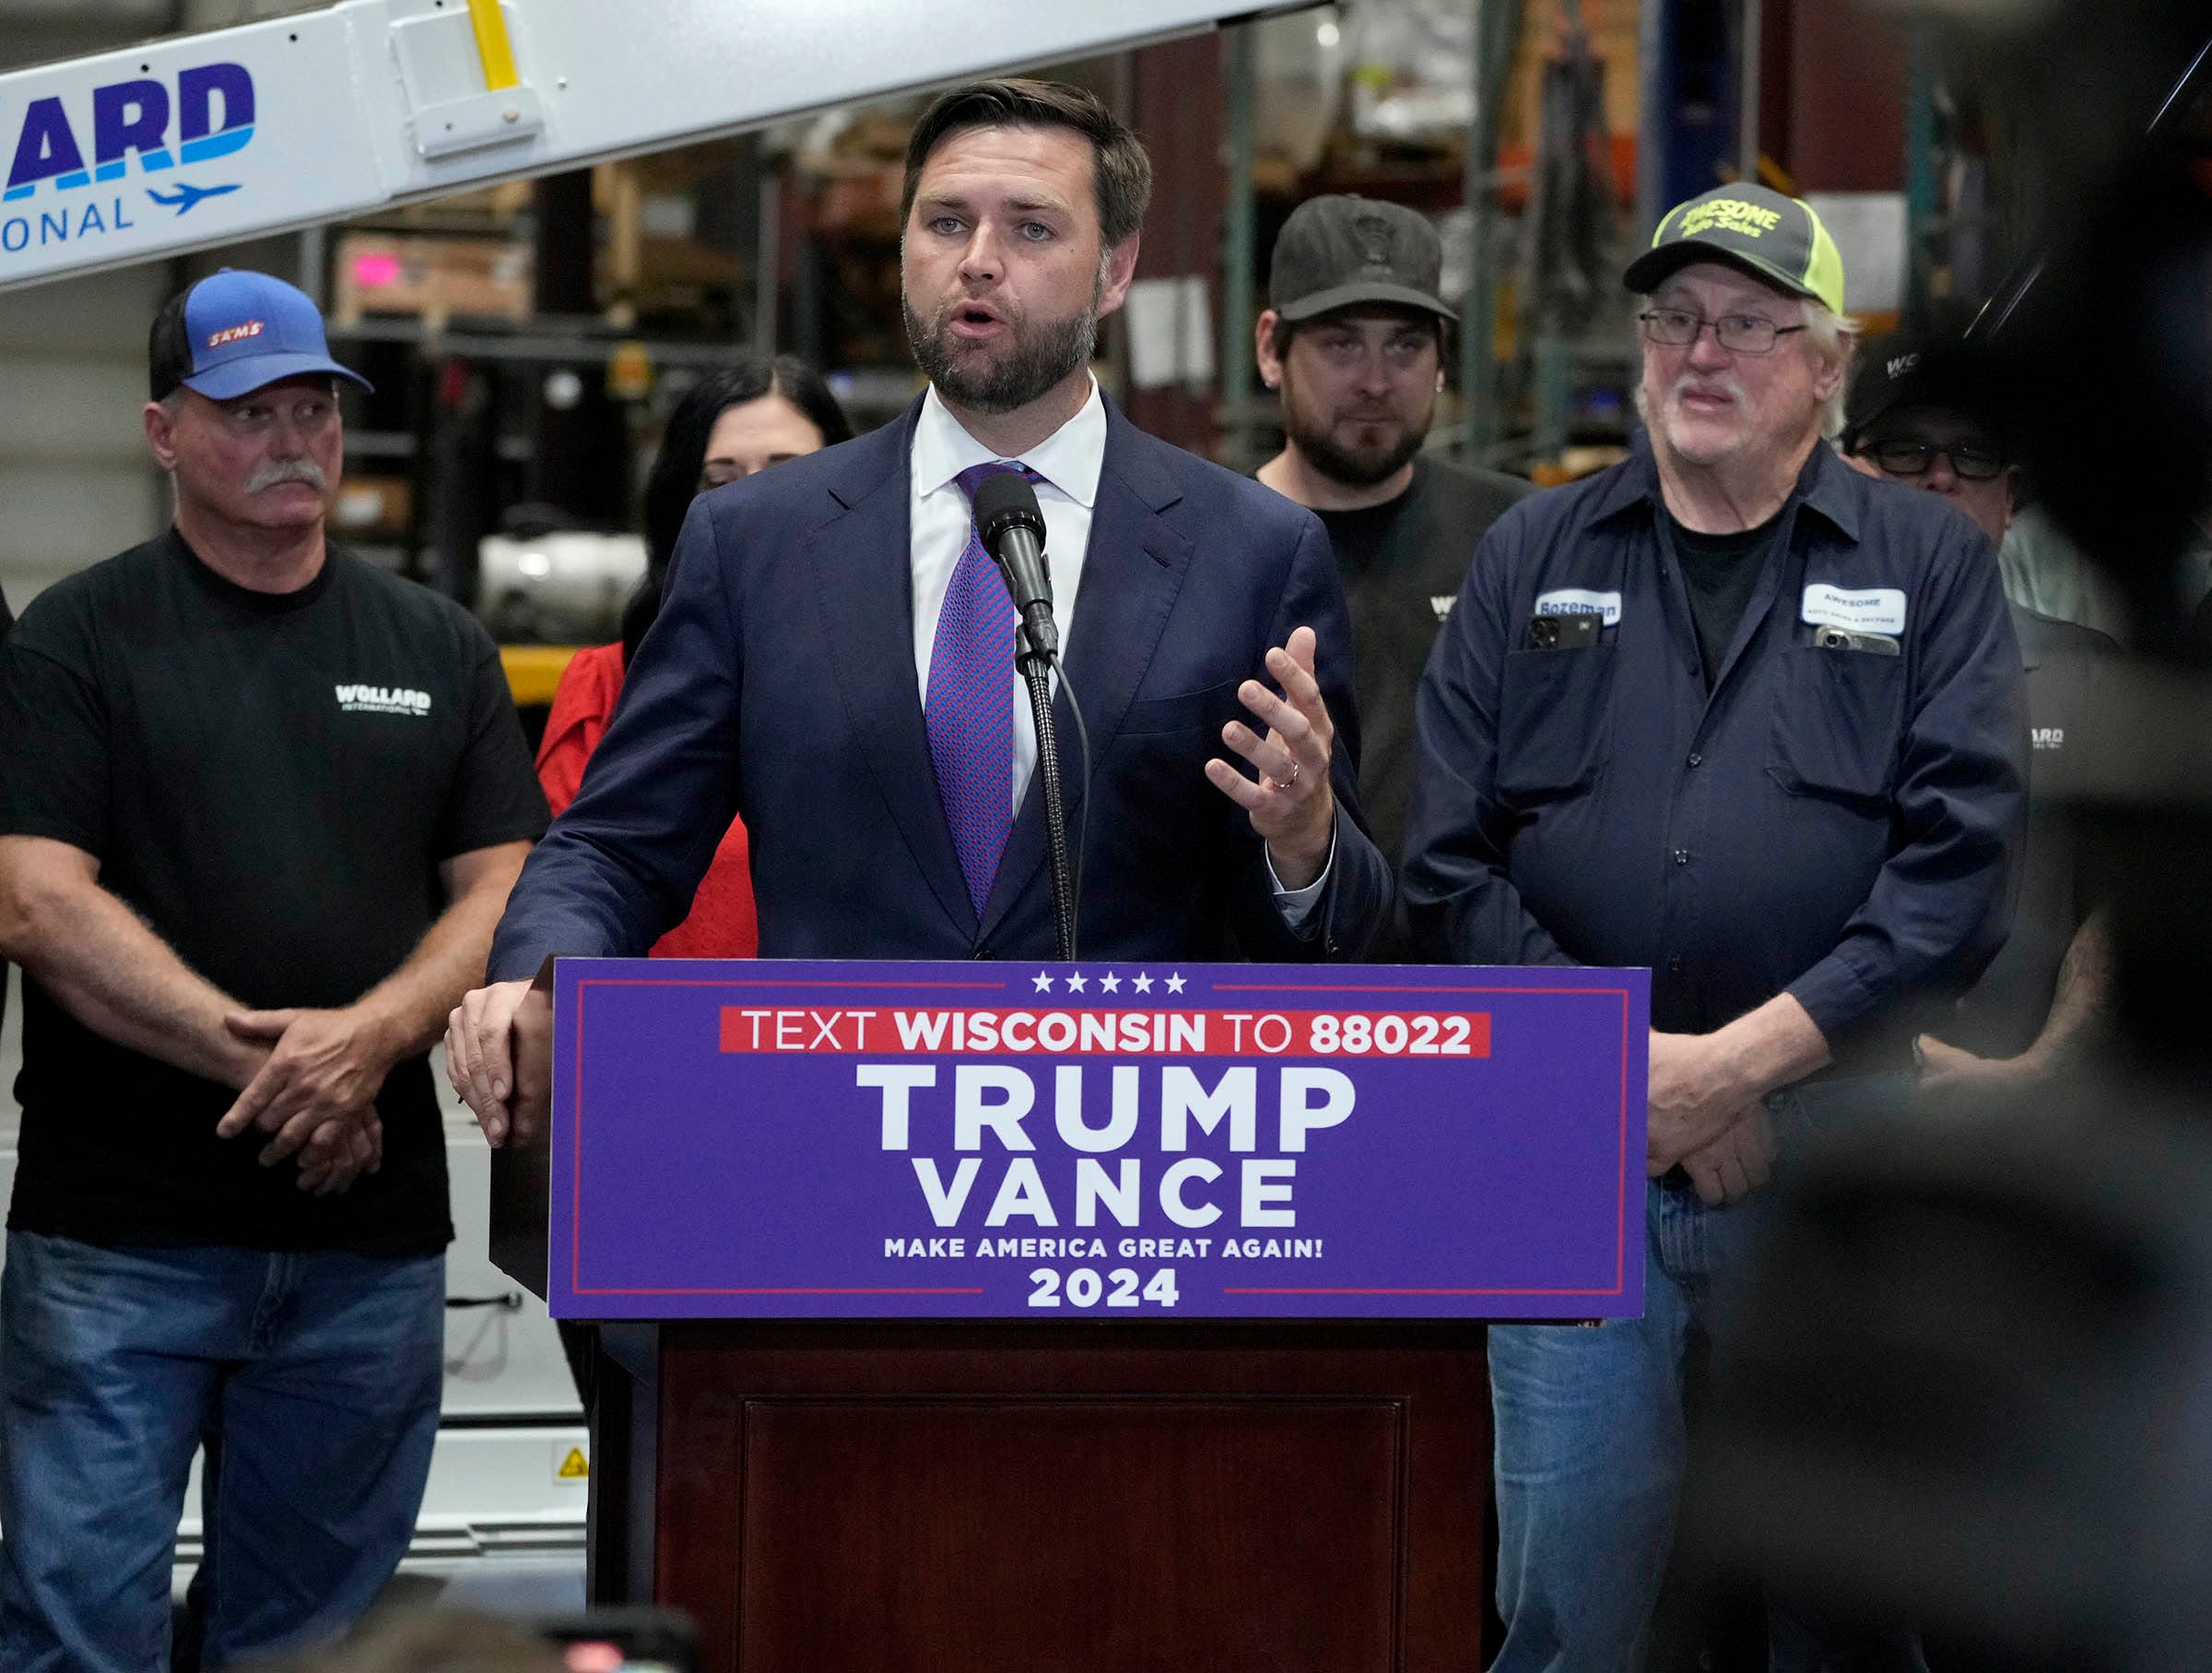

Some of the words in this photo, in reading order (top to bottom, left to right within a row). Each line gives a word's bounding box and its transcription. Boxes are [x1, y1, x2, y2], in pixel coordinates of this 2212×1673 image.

[1824, 593, 1880, 607] AWESOME
[335, 685, 431, 710] WOLLARD
[740, 1010, 877, 1050] TEXT
[893, 1011, 1206, 1053] WISCONSIN
[1222, 1014, 1292, 1054] TO
[1309, 1014, 1471, 1054] 88022
[856, 1064, 1357, 1153] TRUMP
[911, 1157, 1296, 1229] VANCE
[884, 1238, 965, 1257] MAKE
[975, 1238, 1108, 1258] AMERICA
[1118, 1238, 1212, 1258] GREAT
[1221, 1238, 1324, 1258] AGAIN!
[1028, 1267, 1180, 1308] 2024
